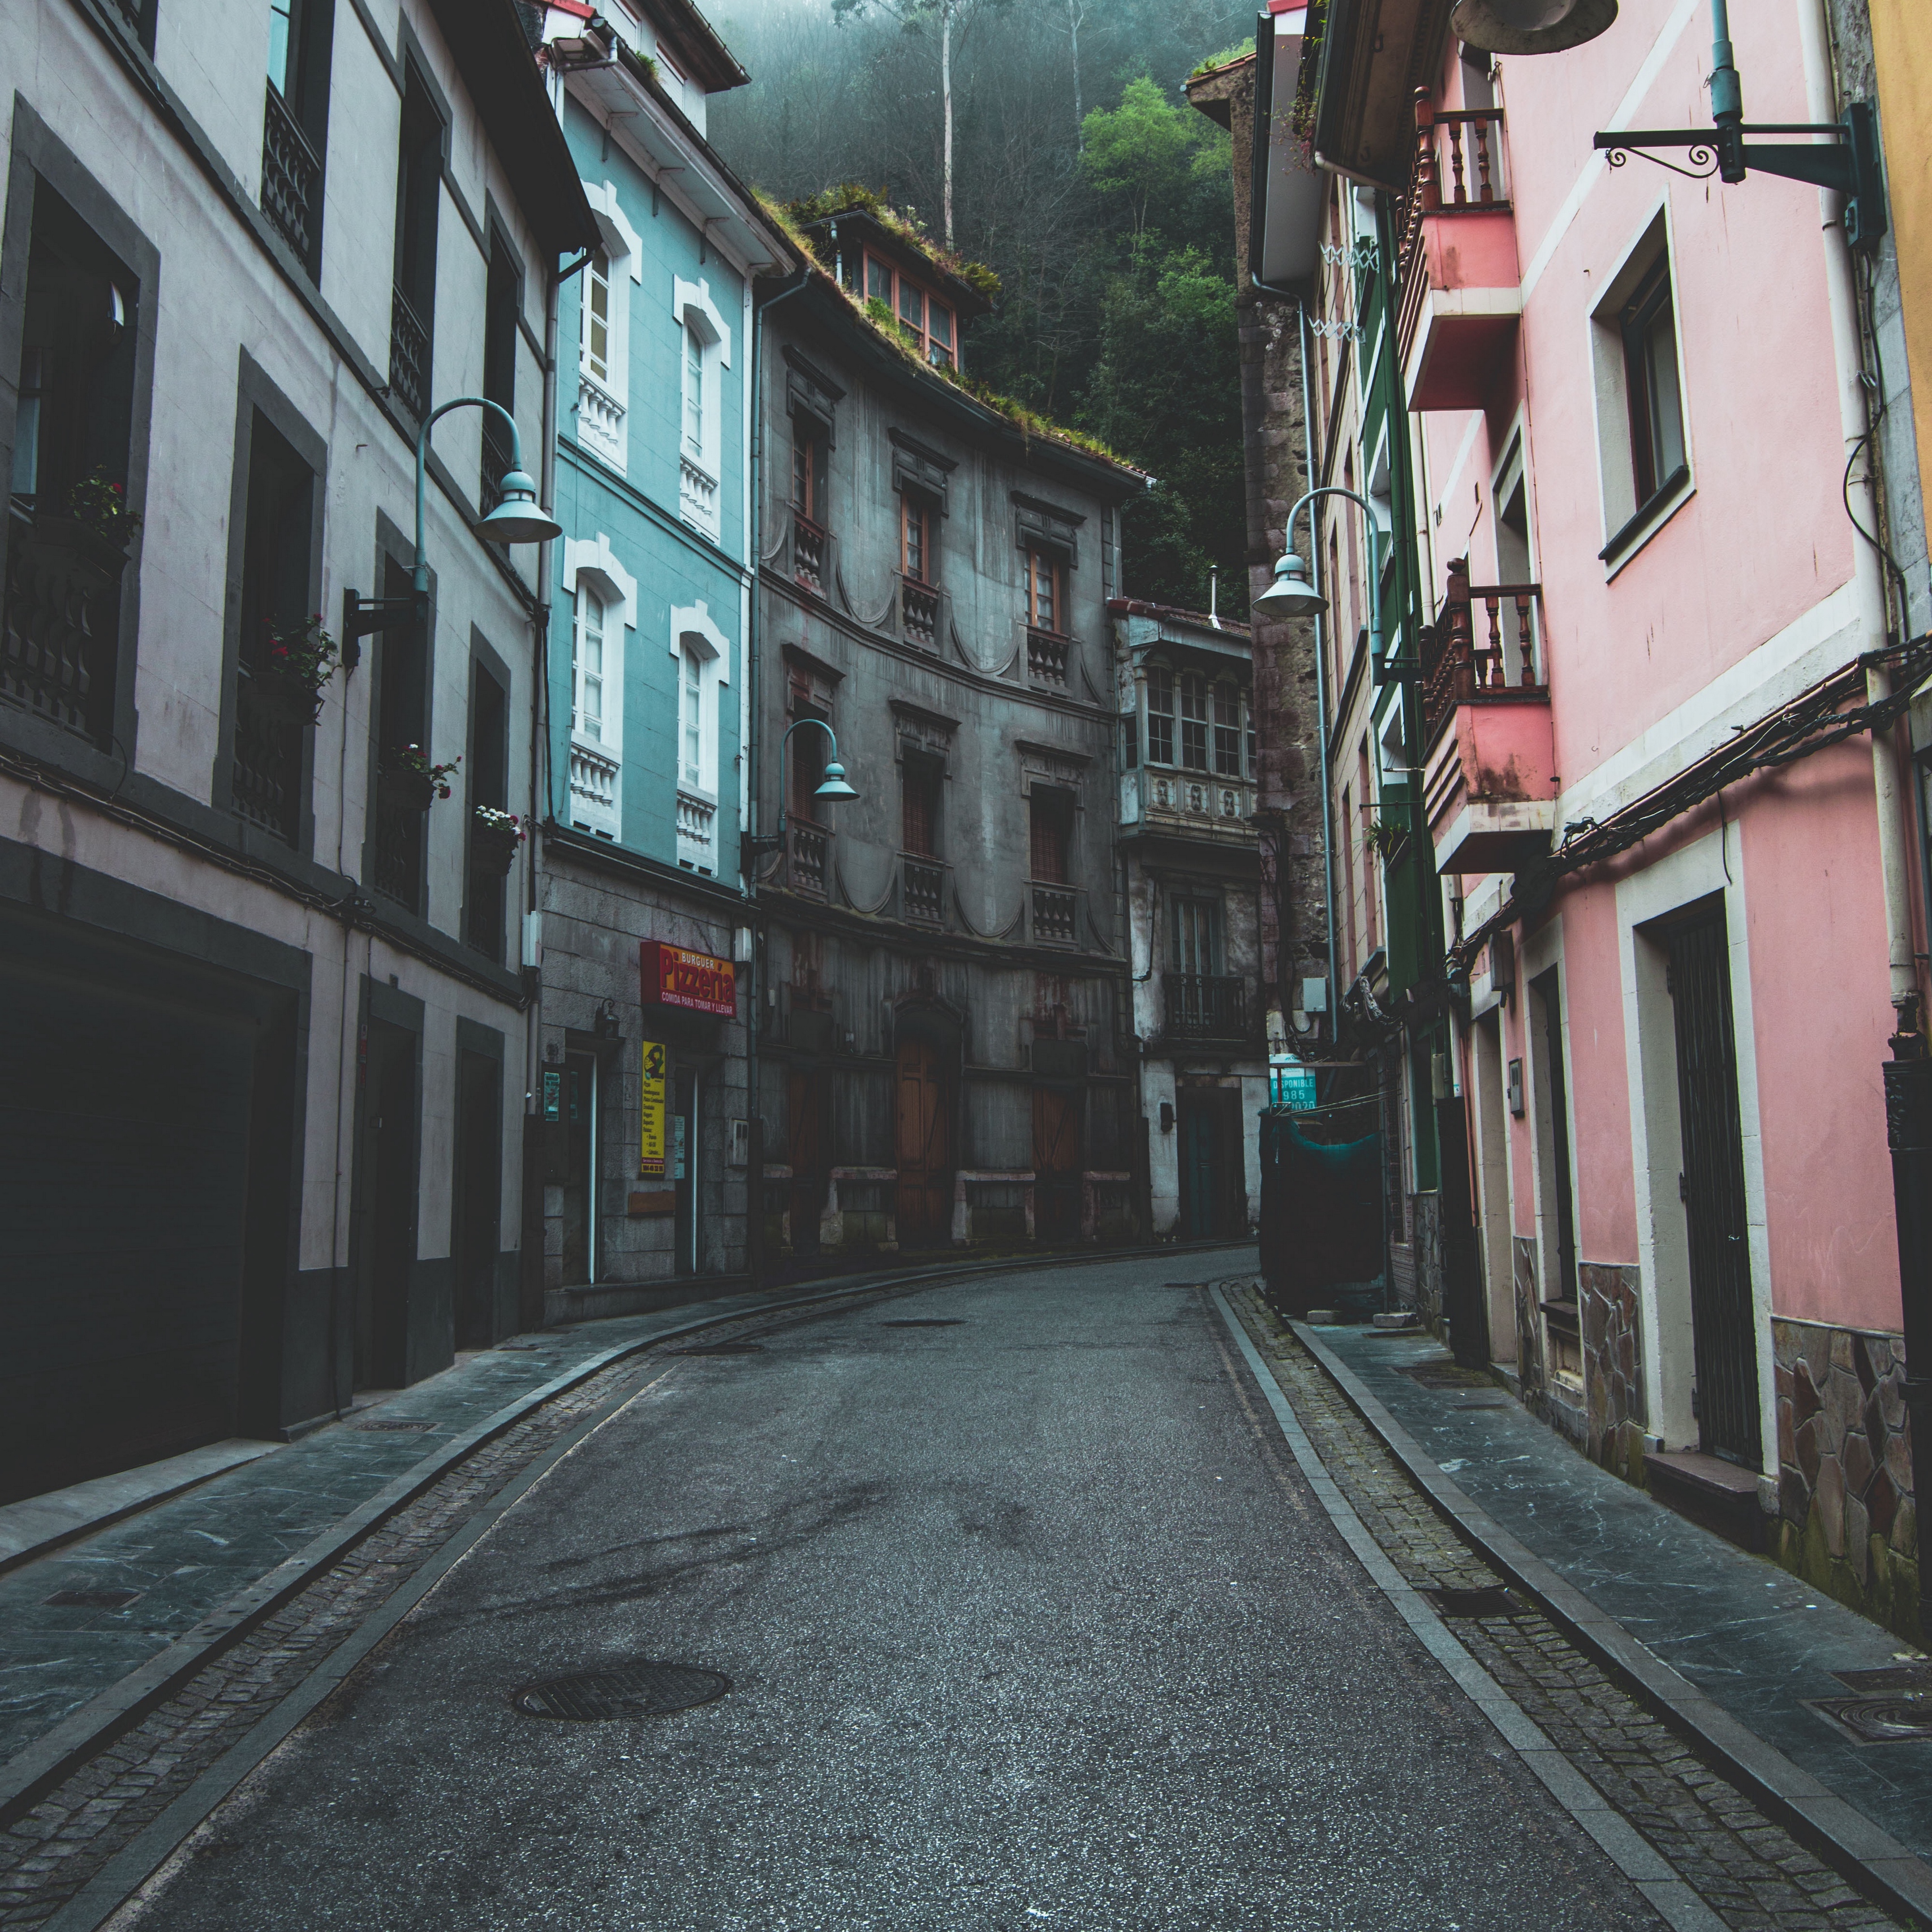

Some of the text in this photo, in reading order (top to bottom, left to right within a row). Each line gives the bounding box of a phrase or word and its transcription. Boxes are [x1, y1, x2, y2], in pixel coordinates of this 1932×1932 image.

[682, 952, 714, 970] BURGUER
[661, 948, 734, 1003] Pizzería
[662, 991, 680, 1004] COMIDA
[682, 996, 694, 1008] PARA
[695, 999, 711, 1011] TOMAR
[716, 1004, 733, 1014] LLEVAR
[1273, 1078, 1313, 1089] DSPONIBLE
[1283, 1090, 1305, 1100] 985
